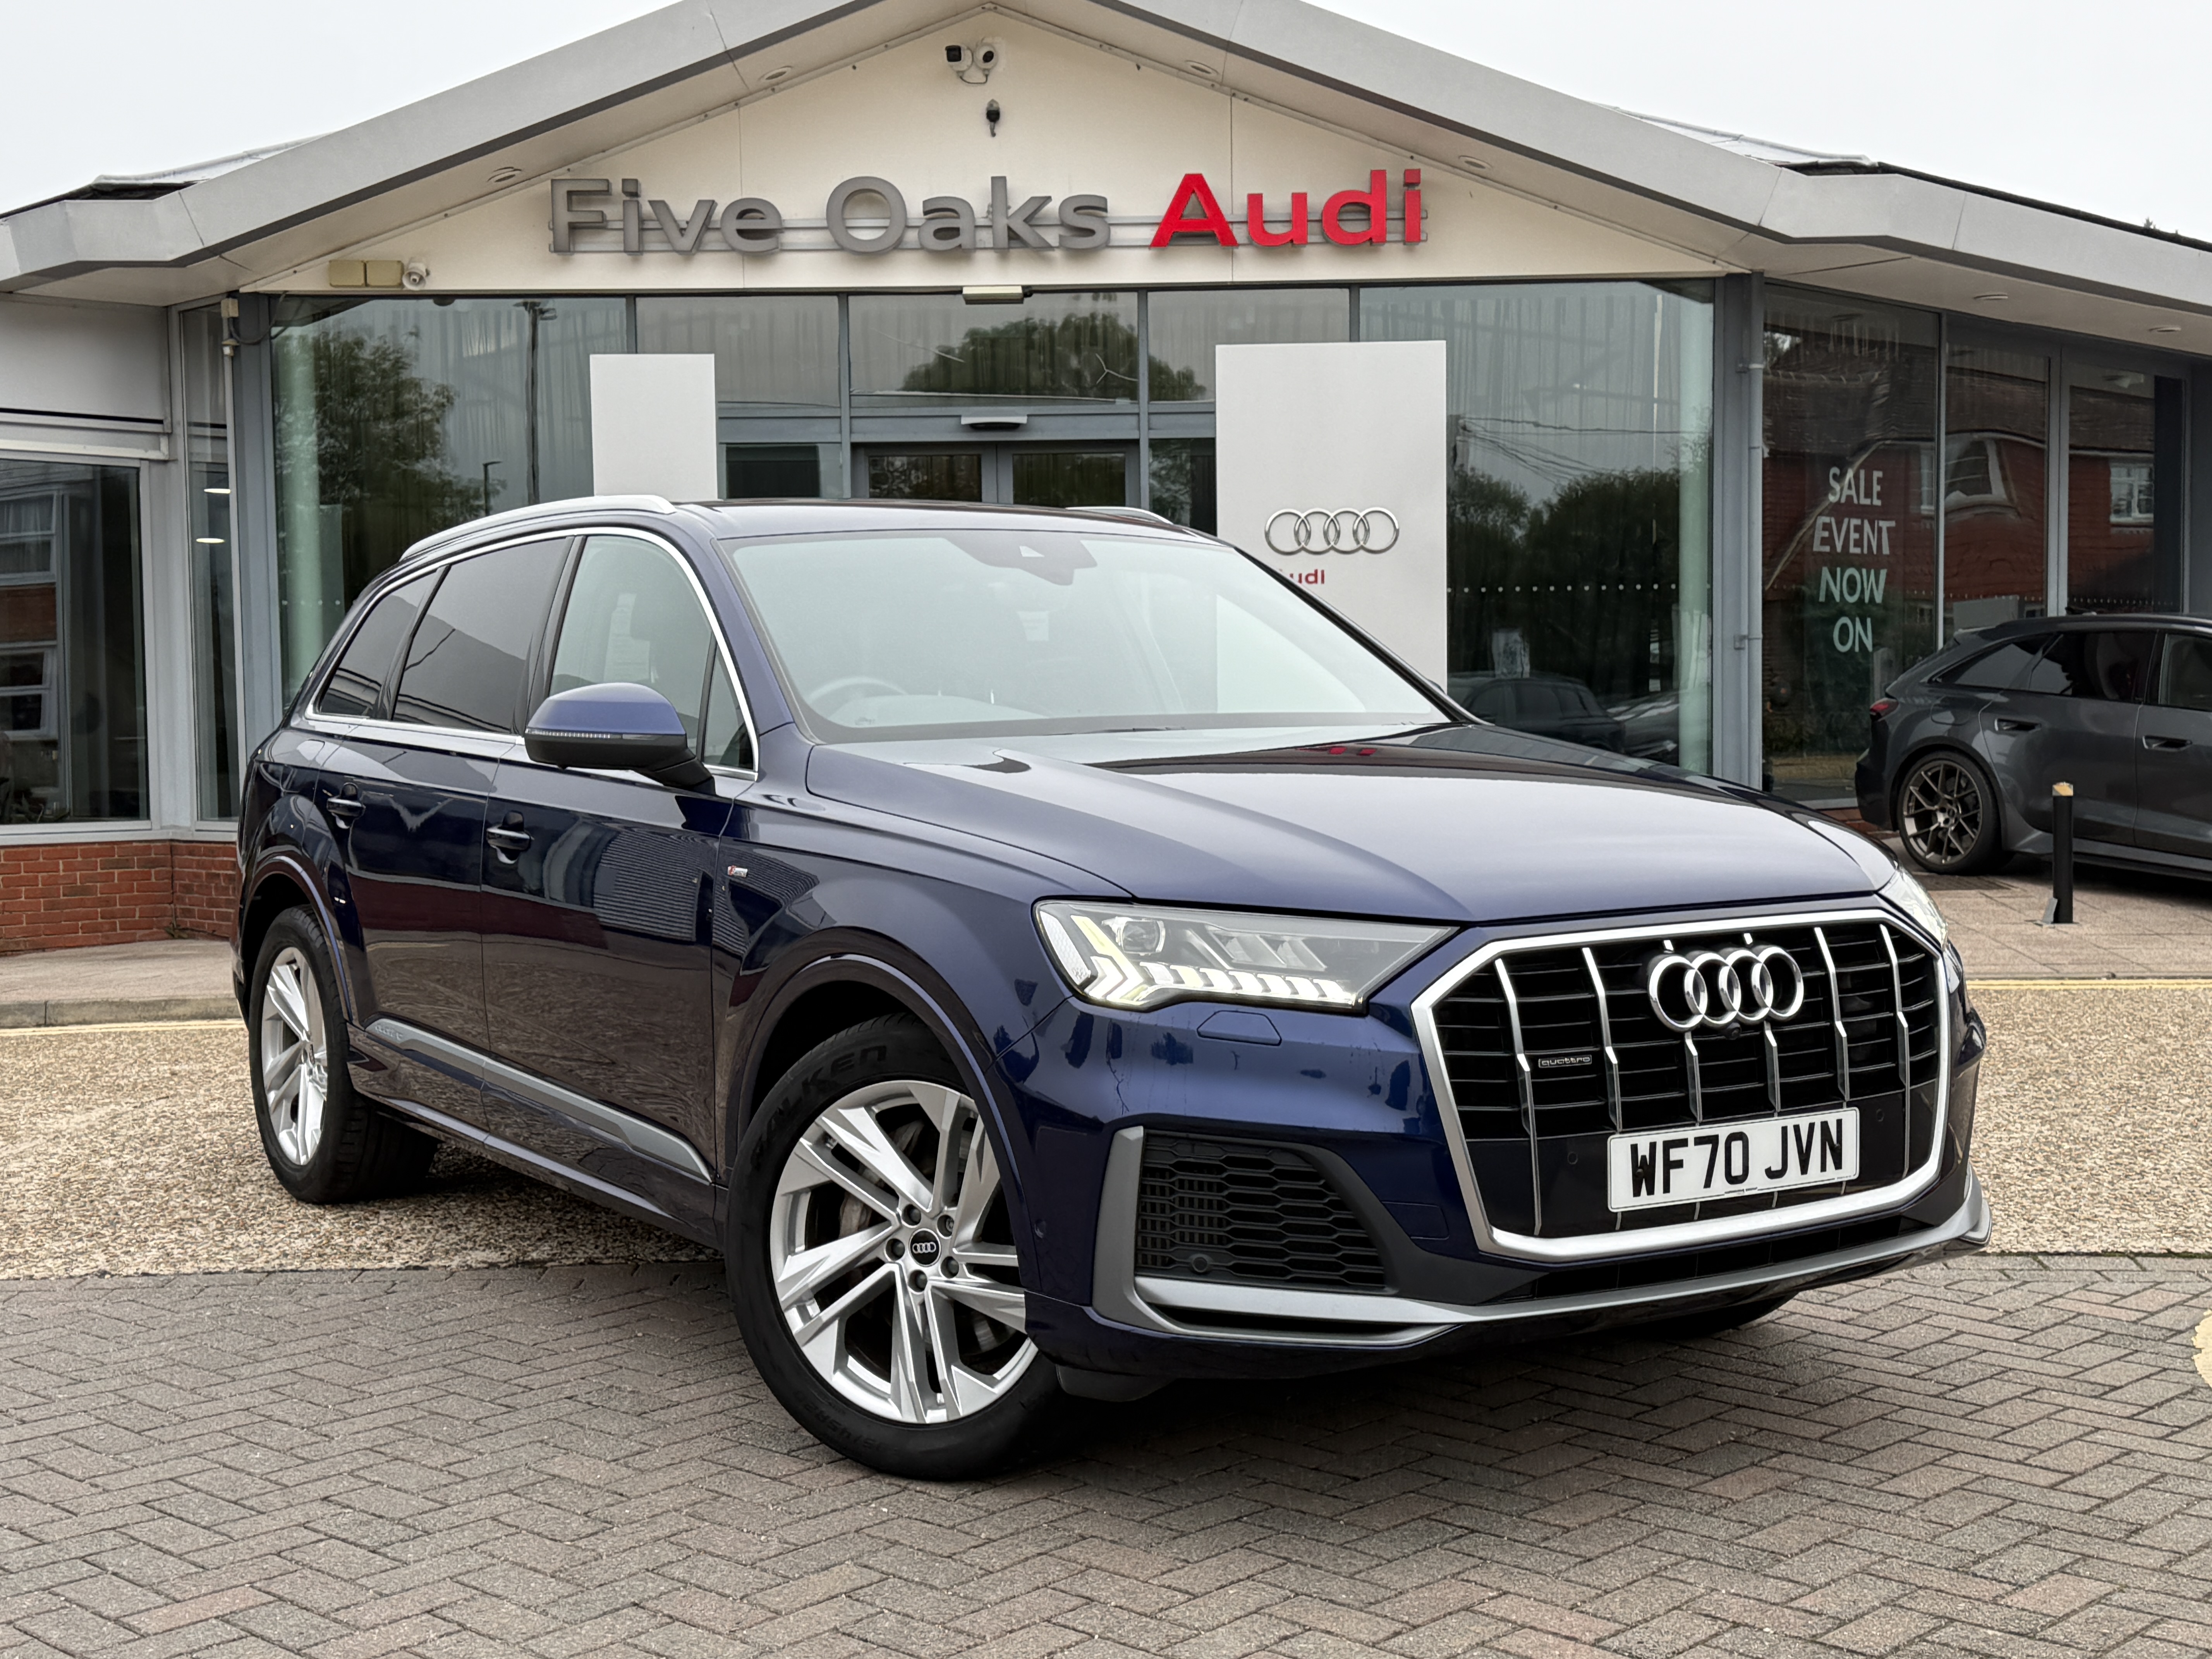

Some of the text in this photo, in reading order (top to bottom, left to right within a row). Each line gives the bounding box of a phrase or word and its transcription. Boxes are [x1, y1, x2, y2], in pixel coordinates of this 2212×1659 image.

[551, 169, 1422, 254] Five Oaks Audi
[1828, 467, 1883, 506] SALE
[1813, 516, 1896, 555] EVENT
[1279, 569, 1324, 584] udi
[1819, 567, 1887, 603] NOW
[1833, 616, 1873, 652] ON
[1541, 1057, 1590, 1067] quattro
[1630, 1118, 1843, 1198] WF70 JVN
